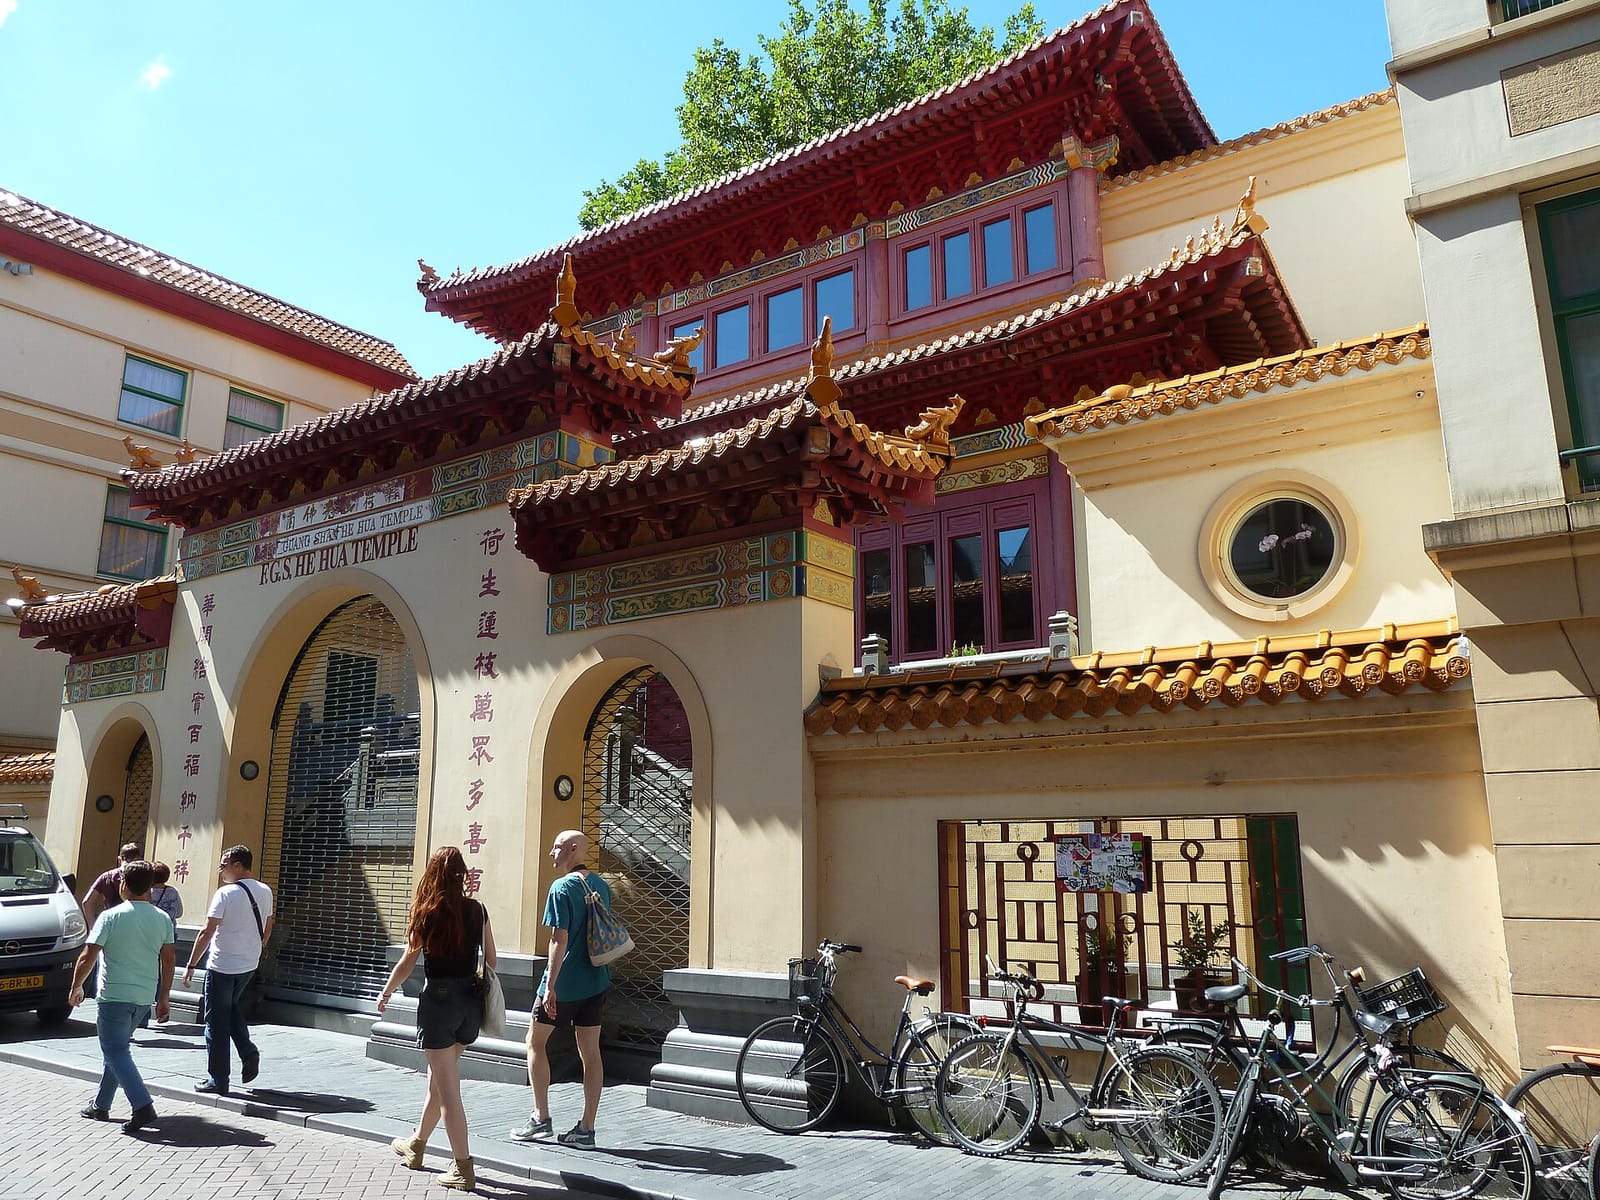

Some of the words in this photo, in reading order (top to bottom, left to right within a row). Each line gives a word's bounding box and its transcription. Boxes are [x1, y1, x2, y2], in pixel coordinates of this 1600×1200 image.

[282, 535, 310, 552] GUANG
[357, 517, 376, 534] HUA
[380, 504, 423, 529] TEMPLE
[295, 551, 316, 578] HE
[318, 544, 348, 572] HUA
[350, 527, 419, 564] TEMPLE
